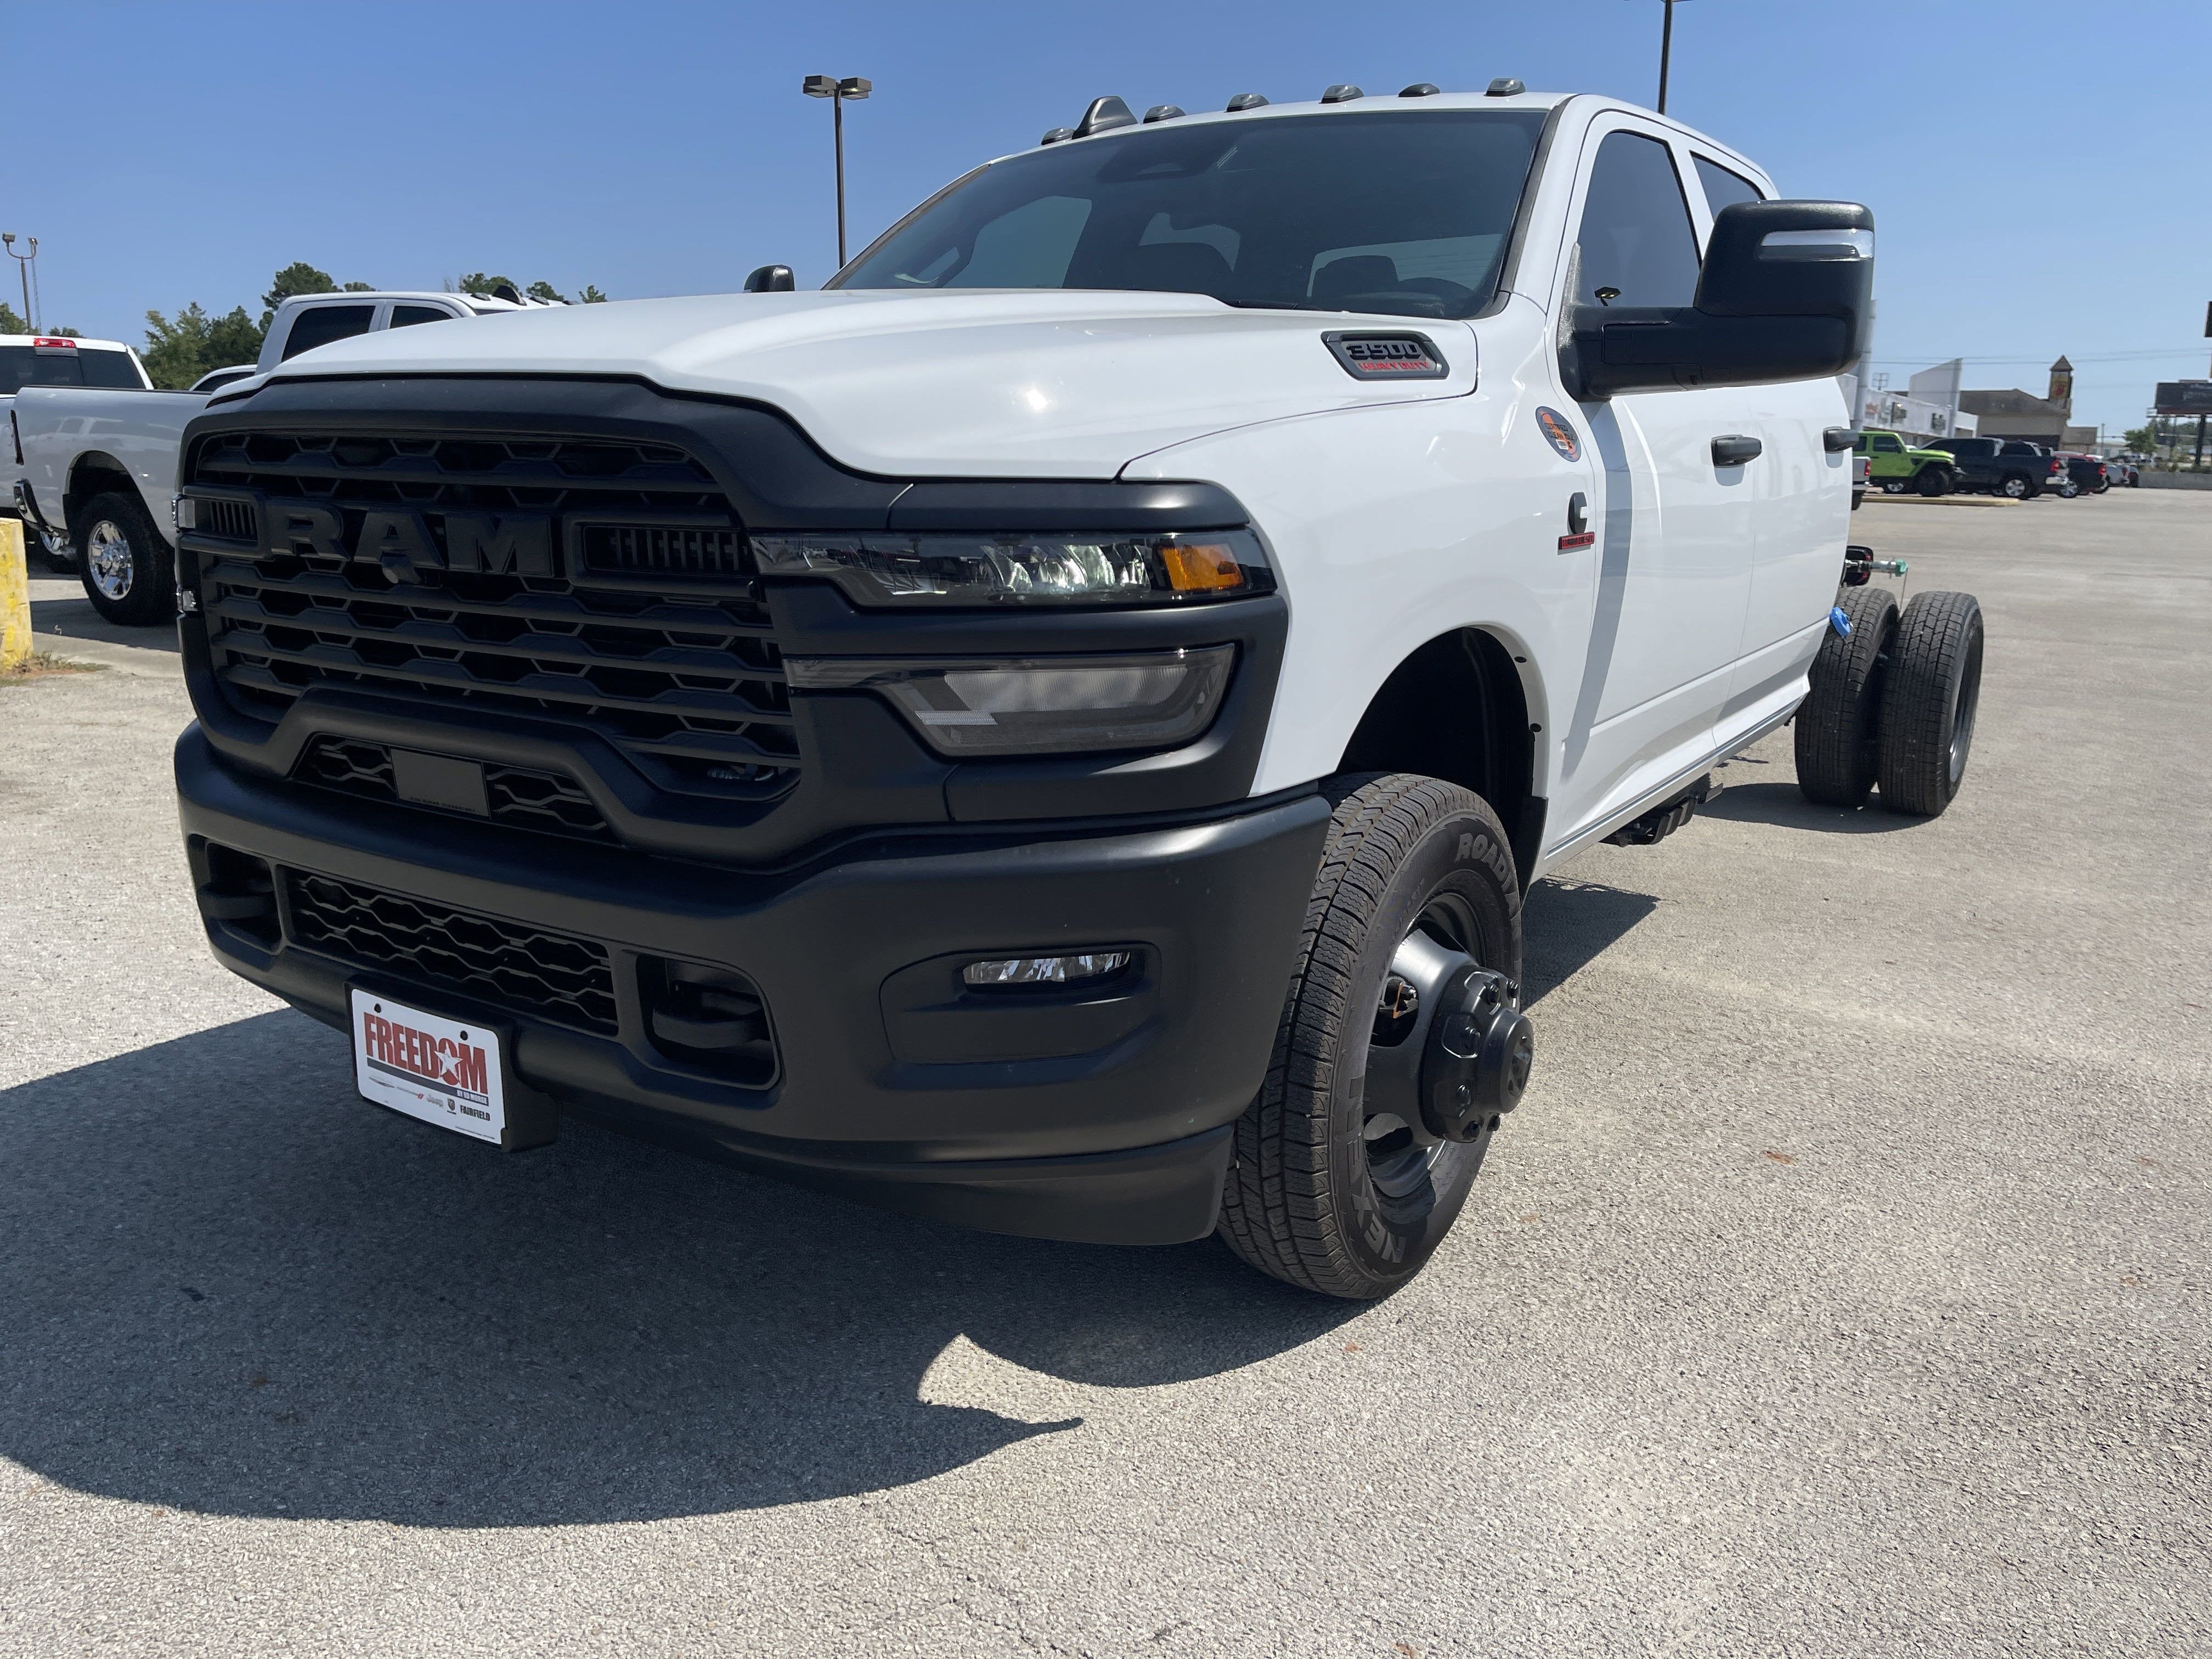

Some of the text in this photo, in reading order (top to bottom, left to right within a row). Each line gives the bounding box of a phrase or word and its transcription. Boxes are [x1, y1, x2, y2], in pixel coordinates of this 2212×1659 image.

[1346, 342, 1422, 360] 3500
[1358, 360, 1430, 371] HEAVY DUTY
[269, 503, 554, 578] RAM
[363, 1012, 488, 1095] FREEDOM
[460, 1104, 490, 1121] FAIRFIELD
